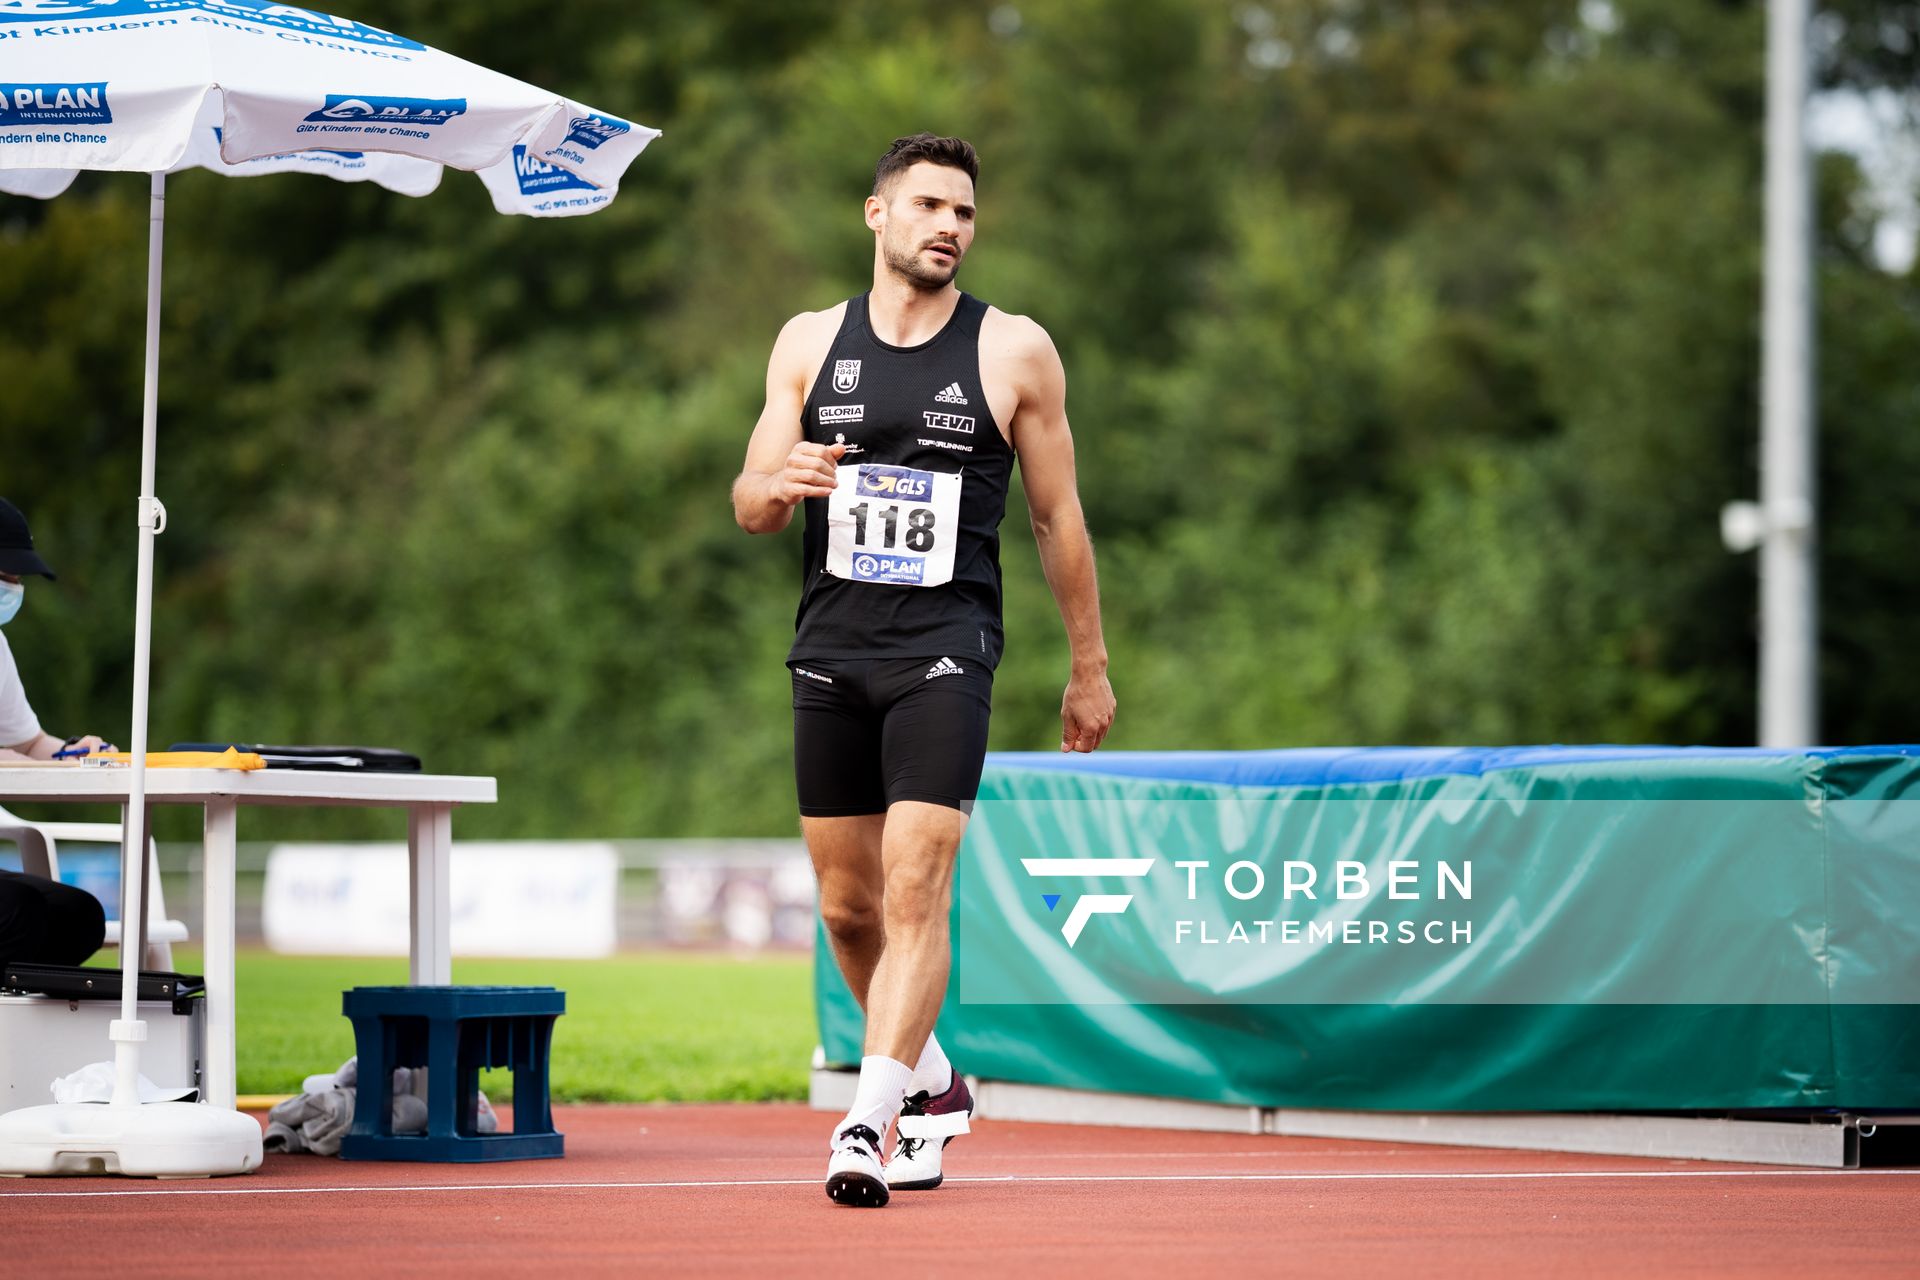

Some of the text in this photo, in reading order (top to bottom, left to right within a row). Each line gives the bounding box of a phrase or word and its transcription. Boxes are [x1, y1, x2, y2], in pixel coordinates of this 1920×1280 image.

[148, 1, 403, 44] INTERNATIONAL
[34, 19, 178, 37] Kindern
[190, 16, 265, 34] eine
[276, 33, 412, 62] Chance
[14, 87, 100, 109] PLAN
[20, 111, 104, 119] INTERNATIONAL
[0, 132, 107, 143] ndern eine Chance
[296, 124, 430, 139] Gibt Kindern eine Chance
[934, 394, 968, 405] adidas
[820, 407, 862, 418] GLORIA
[923, 411, 975, 434] TEVA
[896, 478, 927, 496] GLS
[849, 502, 936, 553] 118
[880, 559, 922, 575] PLAN
[926, 667, 964, 680] adidas
